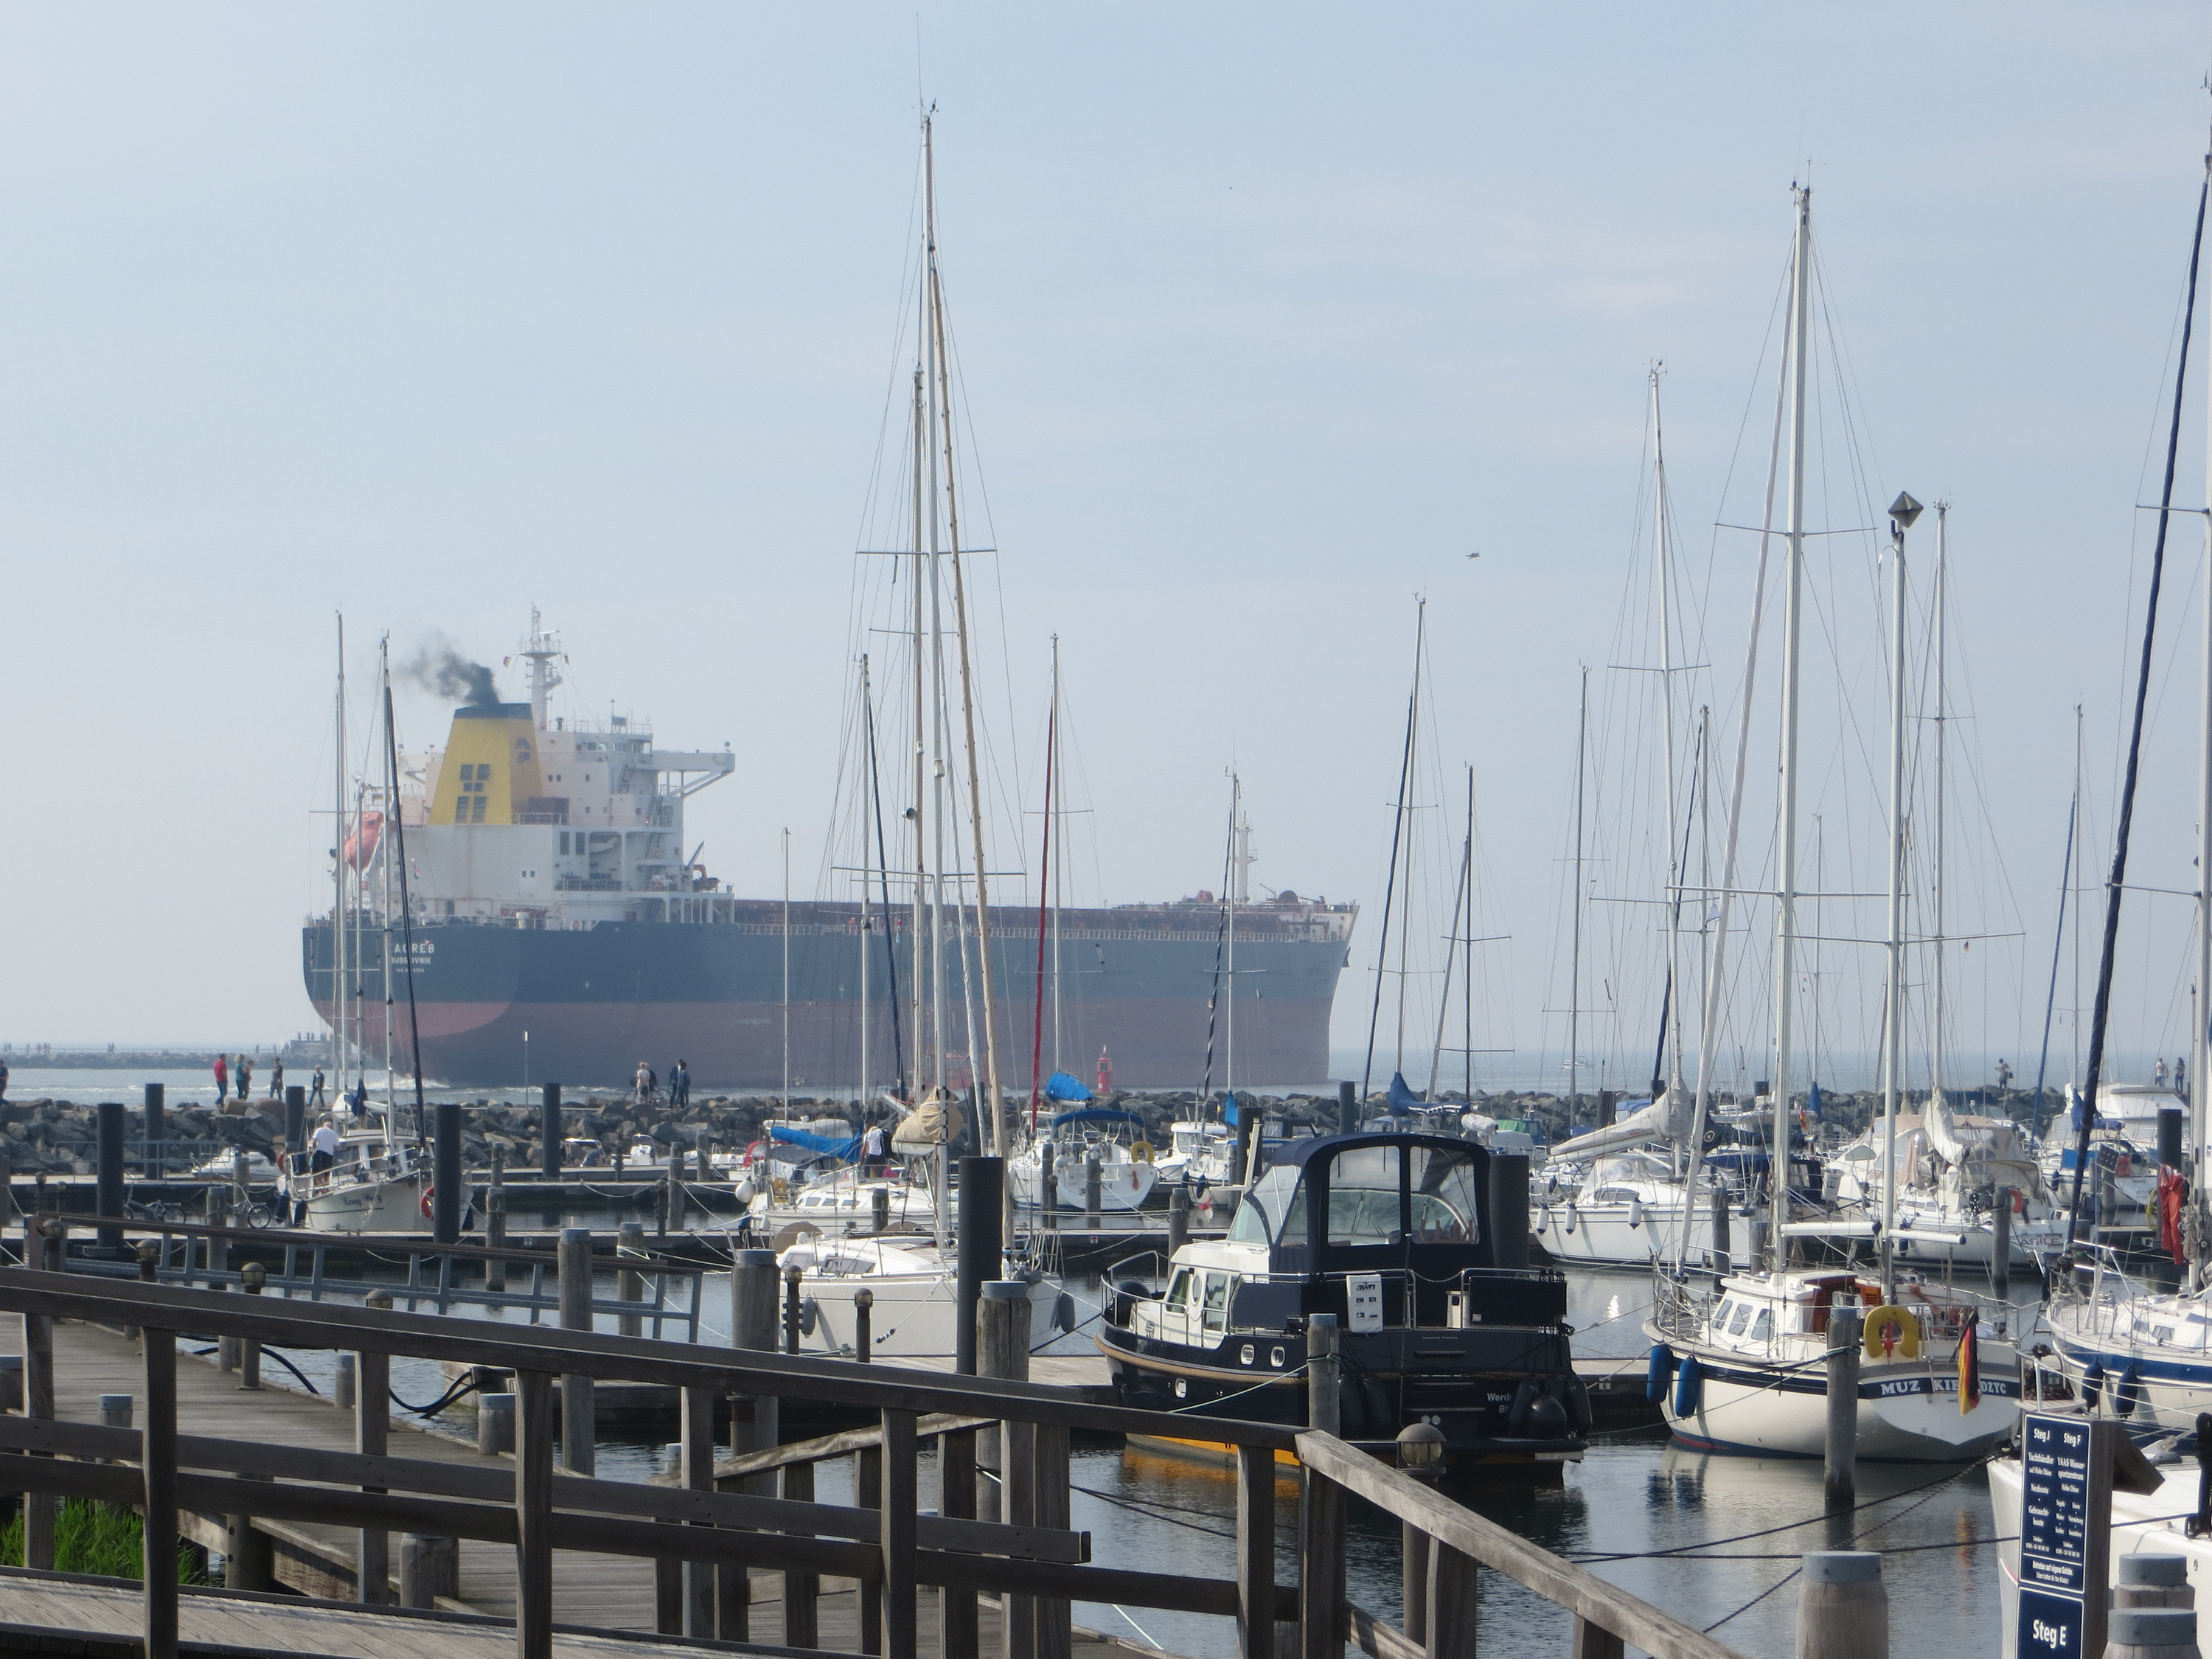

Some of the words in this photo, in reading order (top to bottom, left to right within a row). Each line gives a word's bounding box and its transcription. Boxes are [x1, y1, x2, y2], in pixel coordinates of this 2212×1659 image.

[394, 944, 435, 953] AGREB
[342, 1196, 362, 1207] Long
[1881, 1381, 1920, 1395] MUZ
[2034, 1428, 2046, 1442] Steg
[2047, 1430, 2050, 1441] J
[2063, 1433, 2076, 1447] Steg
[2077, 1434, 2081, 1445] F
[2028, 1452, 2053, 1465] Yachthändler
[2058, 1457, 2069, 1466] YAAS
[2070, 1459, 2085, 1469] Wasser-
[2033, 1517, 2044, 1527] boote
[2033, 1619, 2056, 1649] Steg
[2060, 1626, 2066, 1646] E
